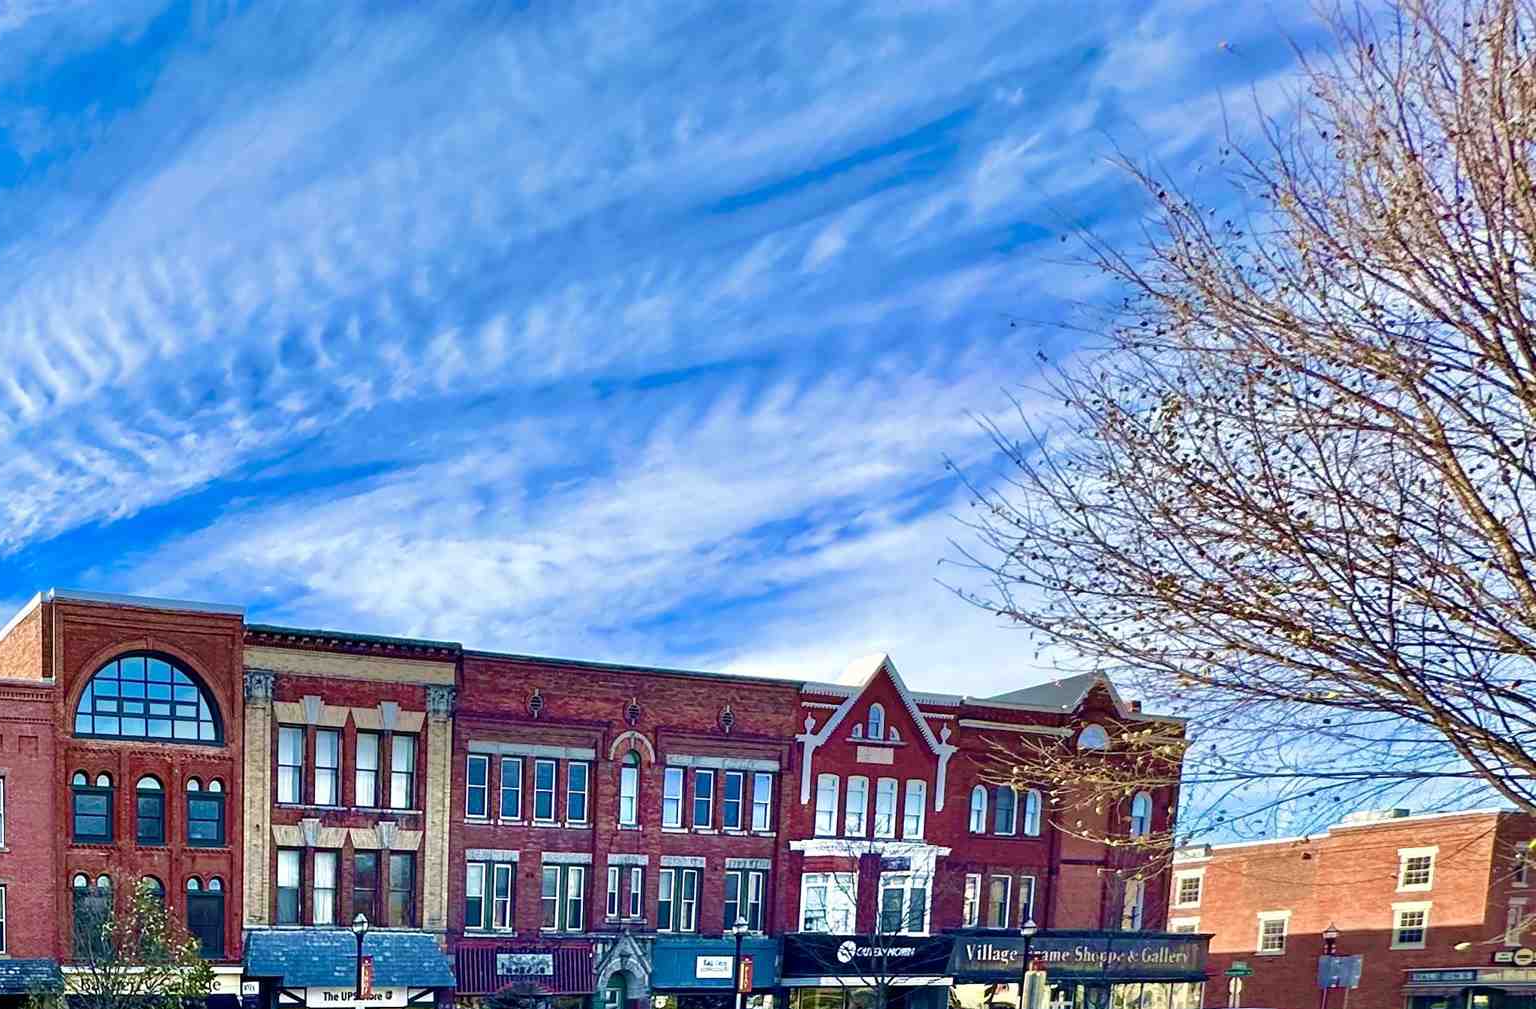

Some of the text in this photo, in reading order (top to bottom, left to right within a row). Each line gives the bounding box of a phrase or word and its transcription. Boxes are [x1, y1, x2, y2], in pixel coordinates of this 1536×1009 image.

[966, 944, 1018, 964] Village
[1074, 945, 1124, 967] Shoppe
[1140, 946, 1190, 965] Gallery
[323, 991, 339, 1001] The
[341, 991, 360, 1001] UPS
